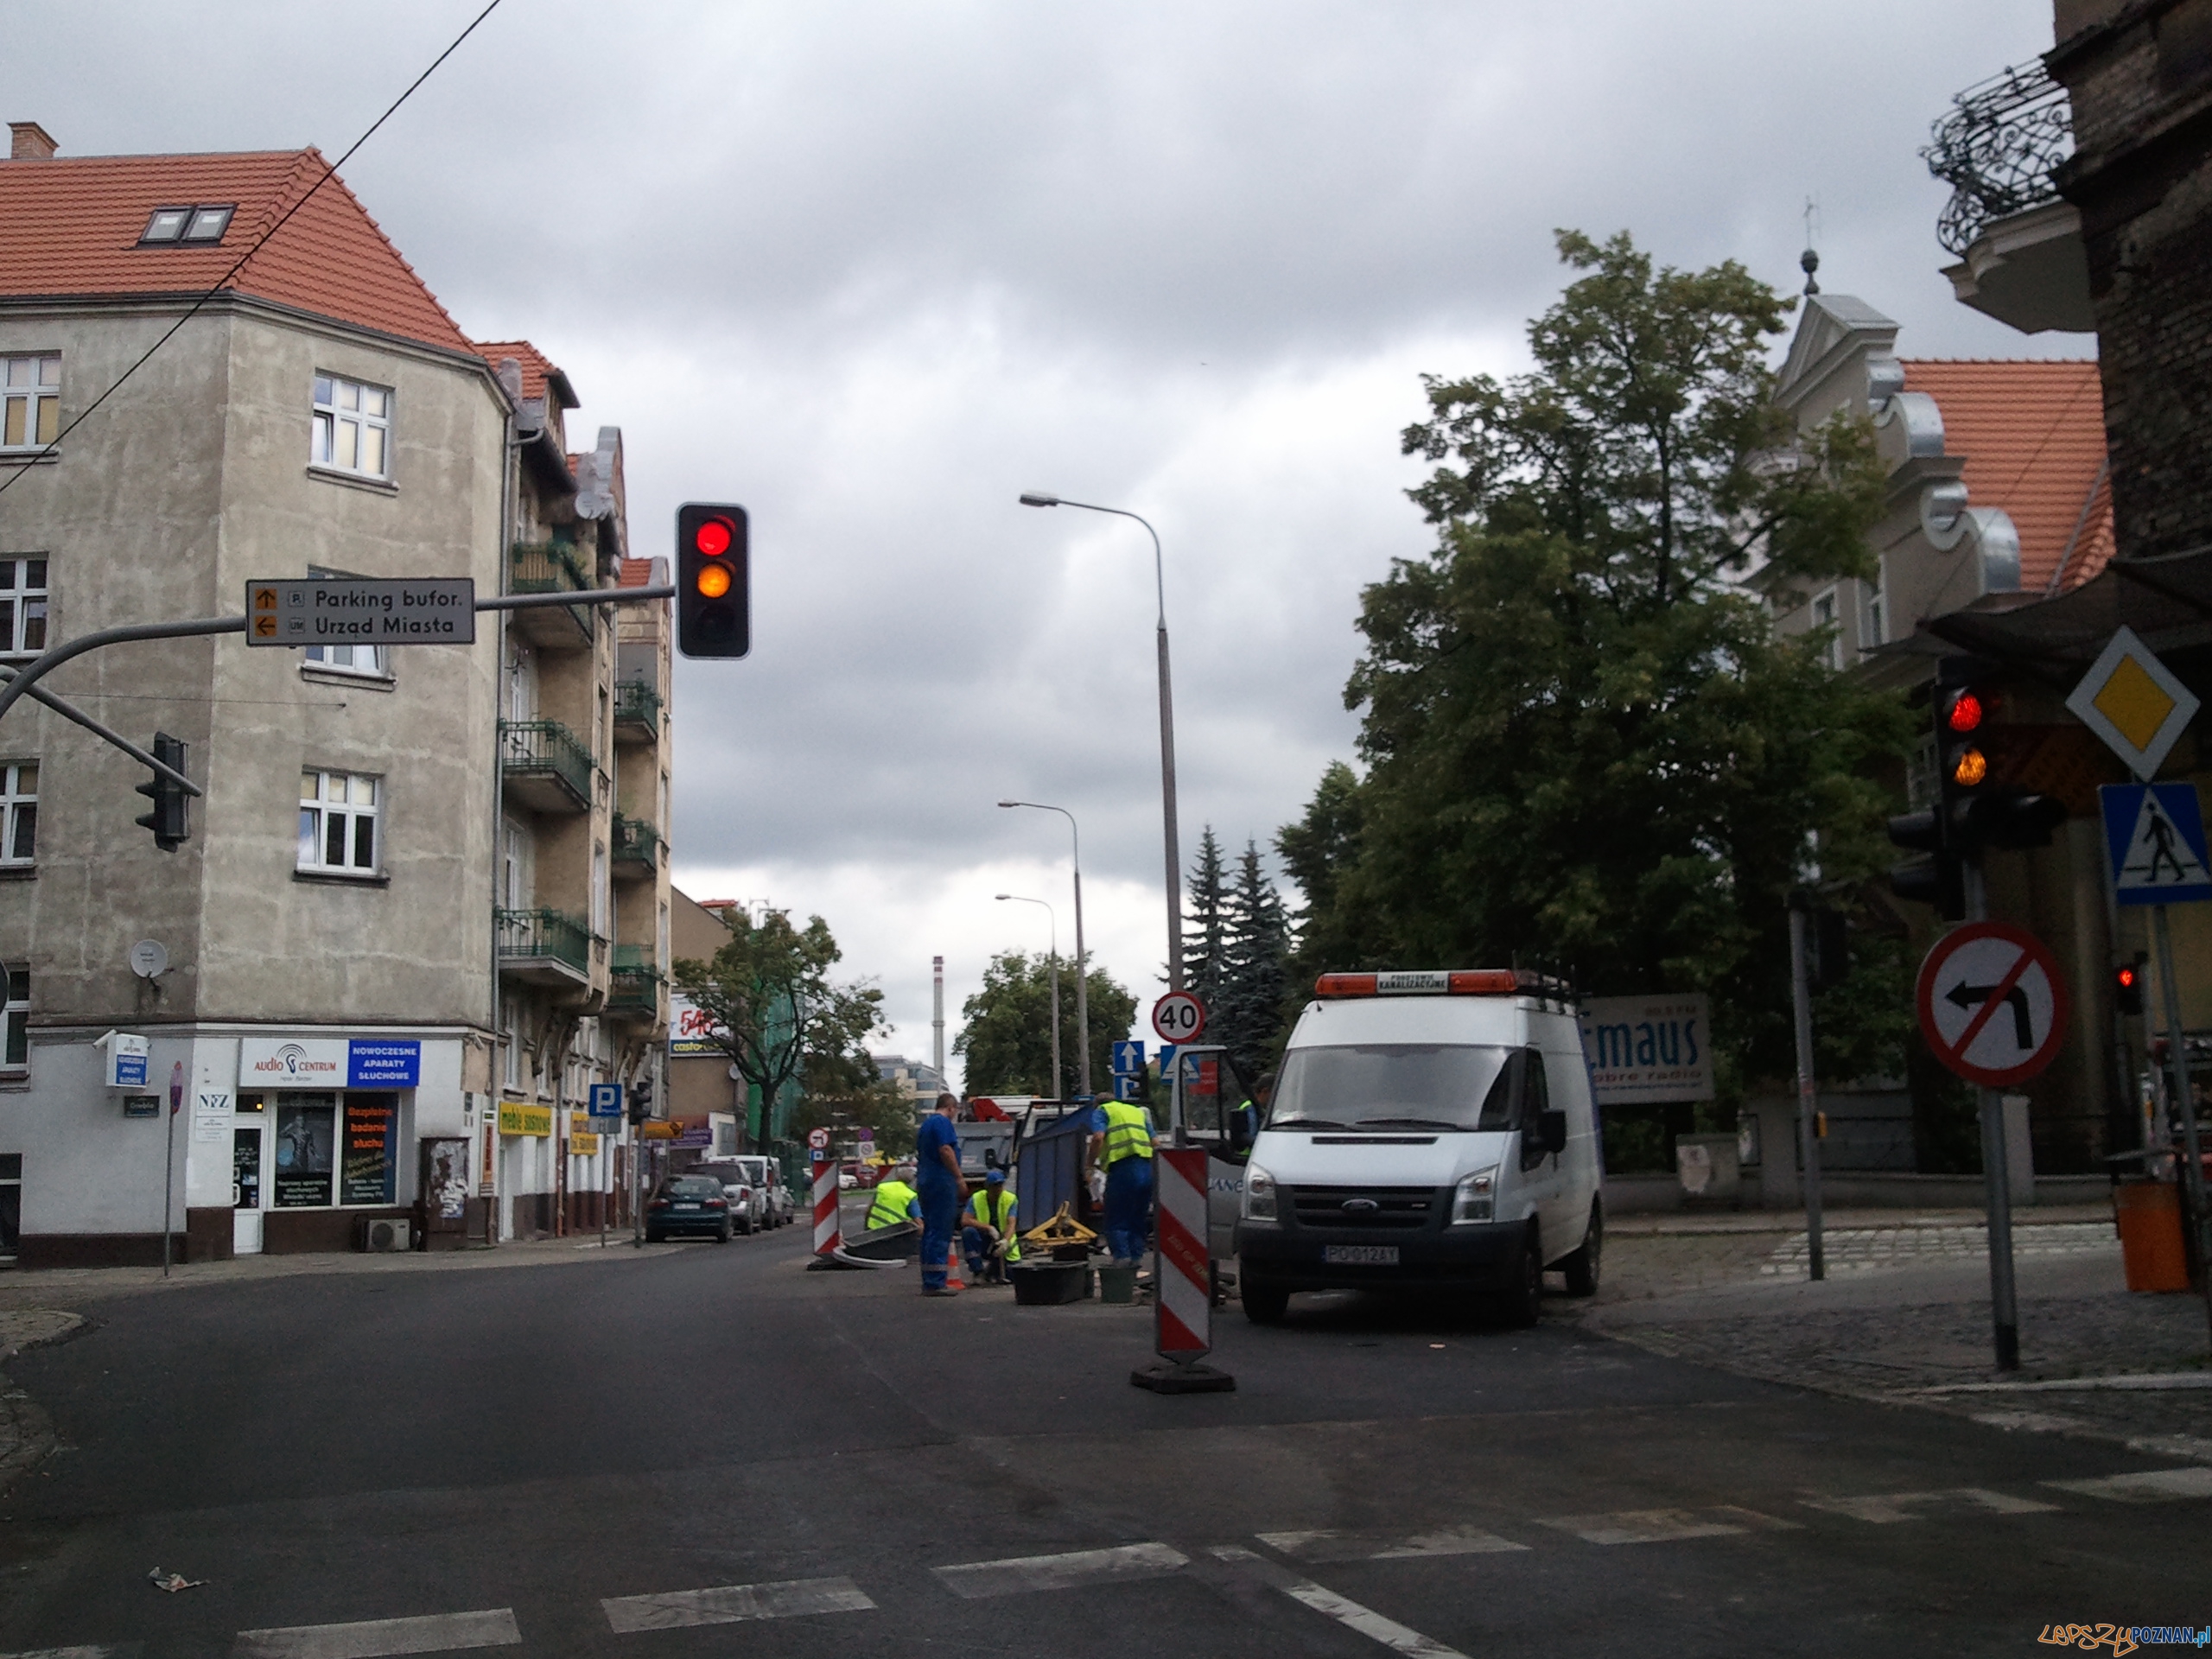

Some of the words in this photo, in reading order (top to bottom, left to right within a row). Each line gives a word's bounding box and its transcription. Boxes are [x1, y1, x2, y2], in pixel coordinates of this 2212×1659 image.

[316, 590, 392, 611] Parking
[403, 590, 462, 607] bufor.
[316, 617, 372, 639] Urząd
[384, 618, 454, 633] Miasta
[1160, 1005, 1197, 1029] 40
[353, 1047, 416, 1056] NOWOCZESNE
[299, 1062, 336, 1071] CENTRUM
[358, 1071, 410, 1080] SŁUCHOWE
[1648, 1070, 1701, 1080] radio
[199, 1094, 229, 1109] NFZ
